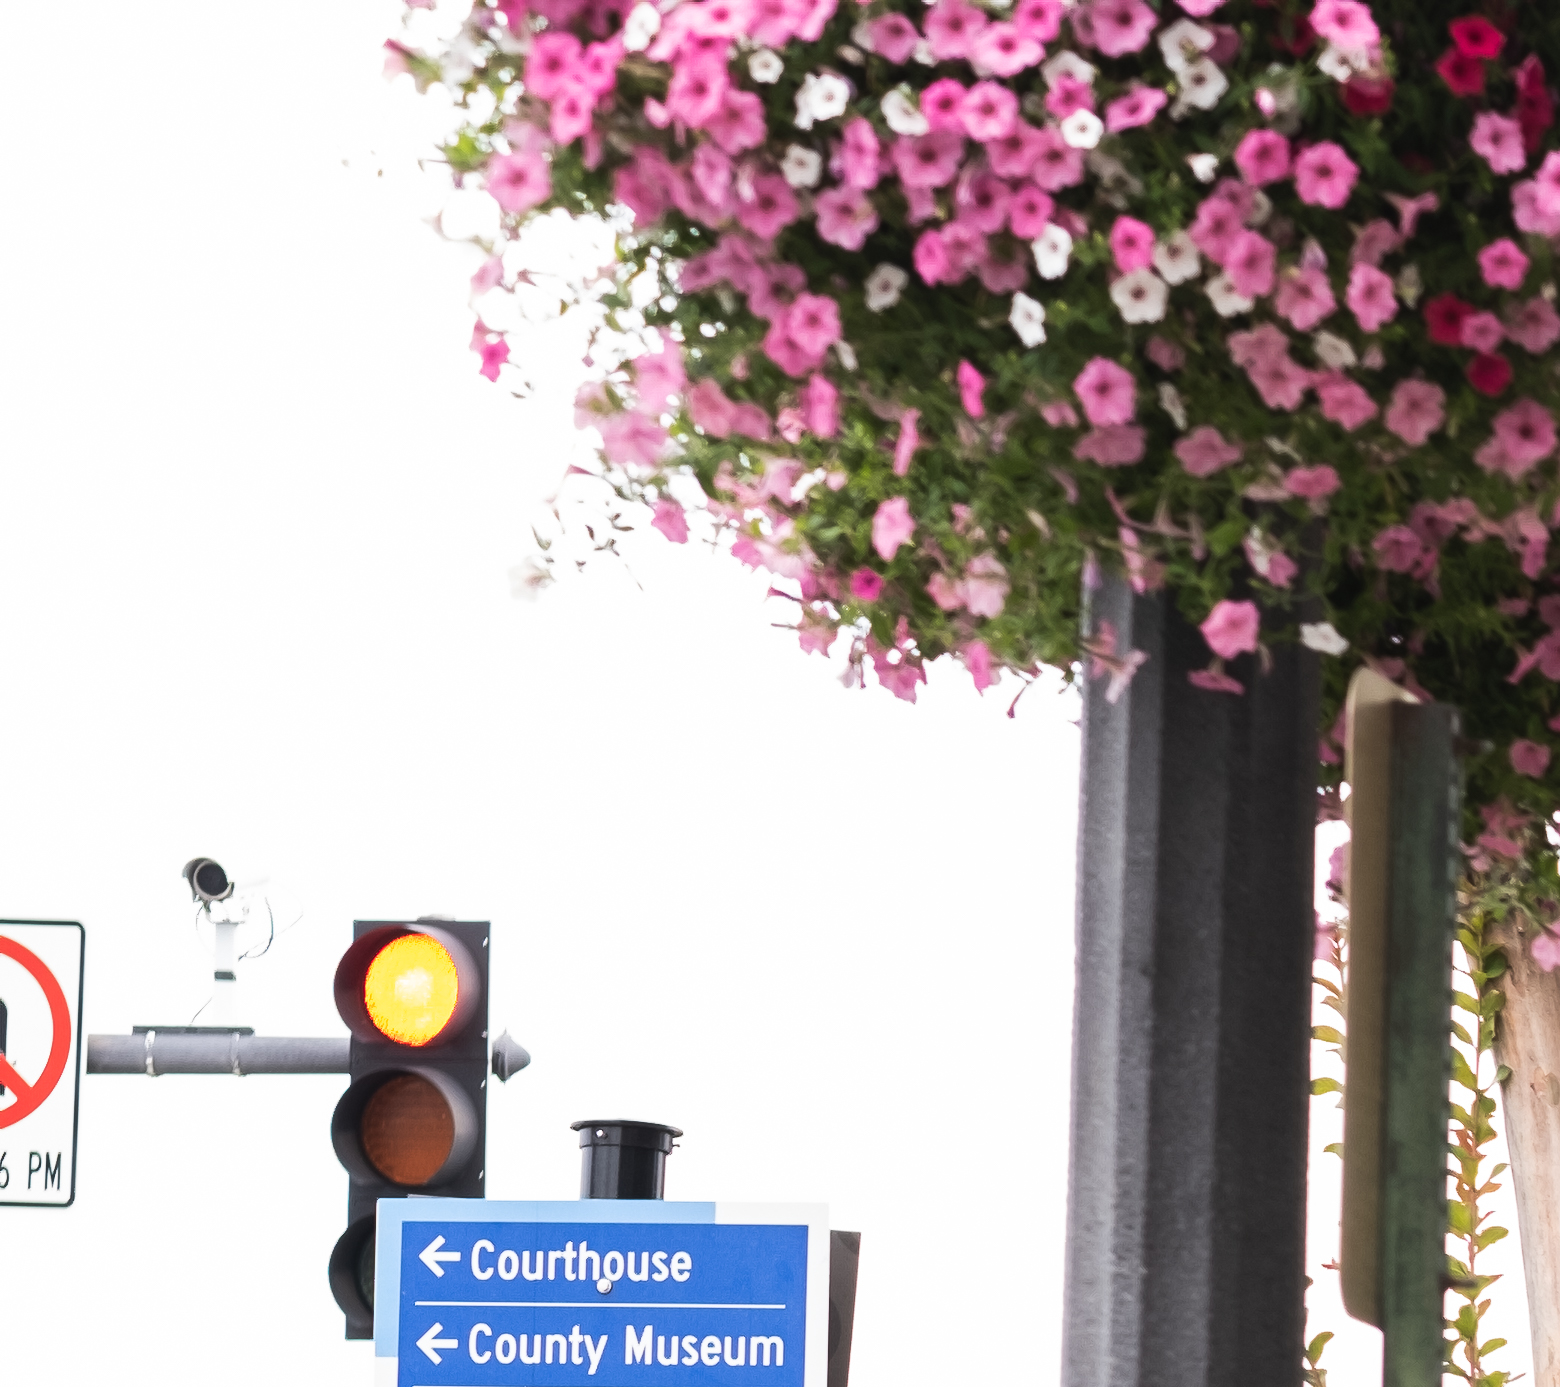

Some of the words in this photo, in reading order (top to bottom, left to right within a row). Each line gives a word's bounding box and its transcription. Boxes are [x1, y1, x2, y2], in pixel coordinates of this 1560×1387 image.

[28, 1151, 62, 1190] PM
[470, 1239, 692, 1283] Courthouse
[468, 1324, 608, 1375] County
[625, 1325, 785, 1368] Museum
